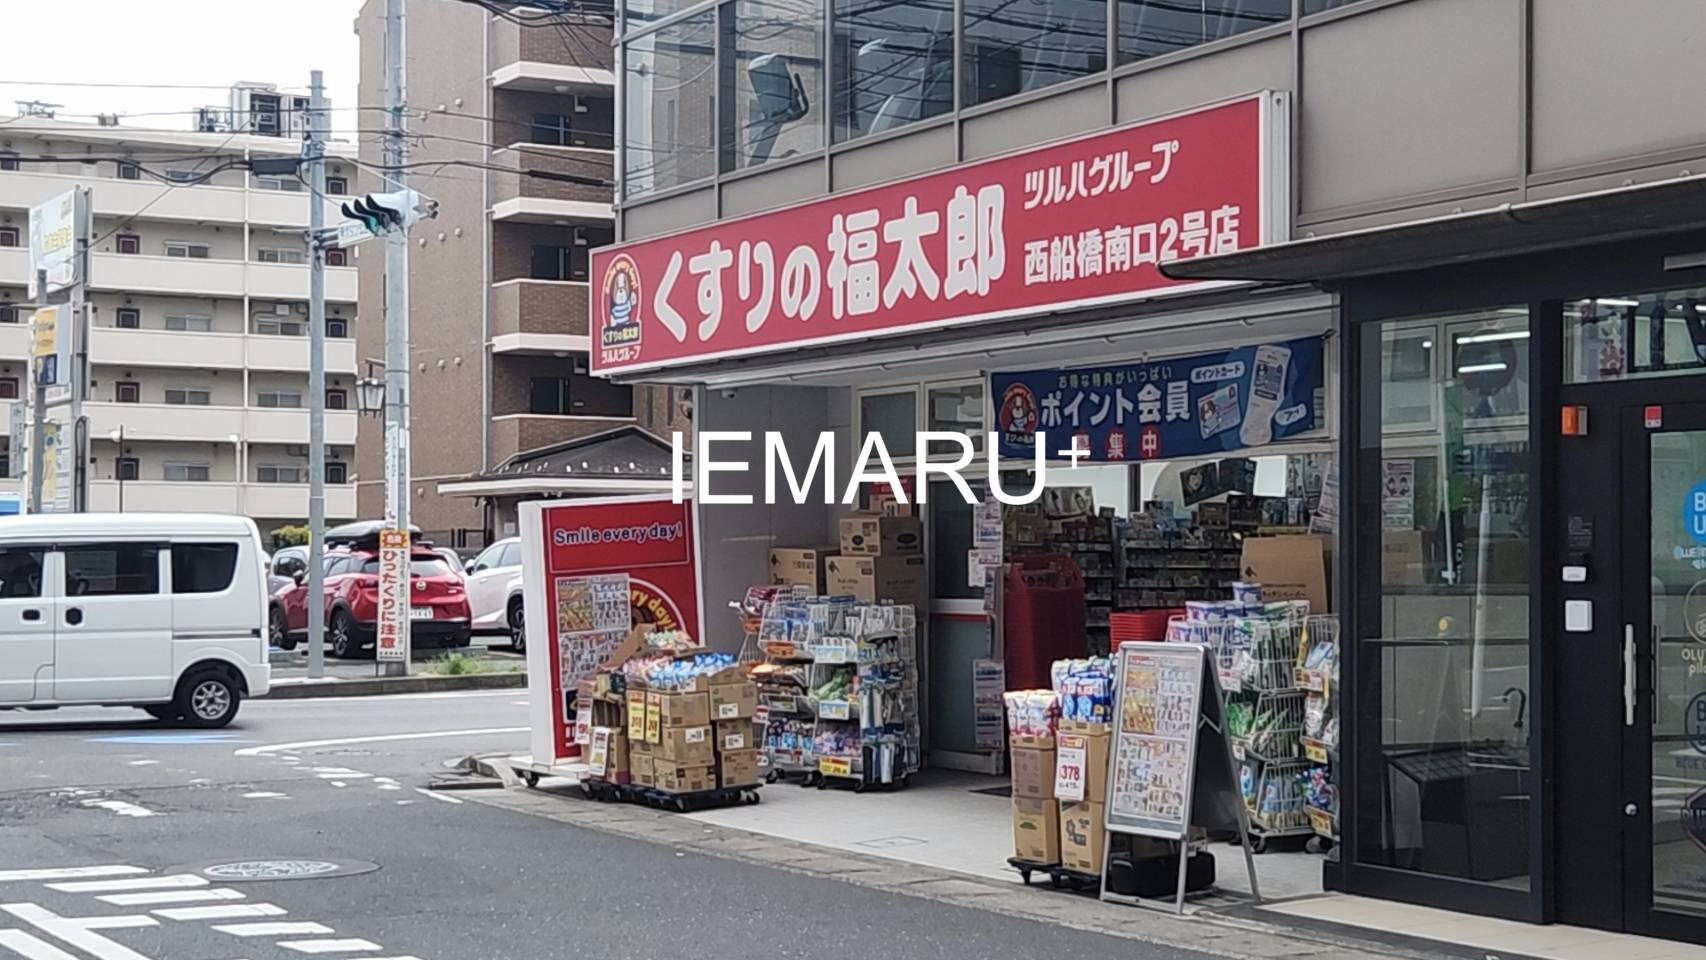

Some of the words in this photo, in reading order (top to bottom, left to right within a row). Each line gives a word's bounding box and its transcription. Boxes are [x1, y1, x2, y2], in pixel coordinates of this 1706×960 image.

[1024, 140, 1179, 209] ツルハグループ
[654, 184, 1005, 342] くすりの福太郎
[1024, 204, 1240, 286] 西船橋南口2号店
[1041, 380, 1190, 427] ポイント会員
[554, 527, 600, 546] Smile
[603, 525, 649, 543] every
[649, 521, 682, 542] day!
[380, 550, 398, 648] ひったくりに注意
[1060, 764, 1080, 781] 378
